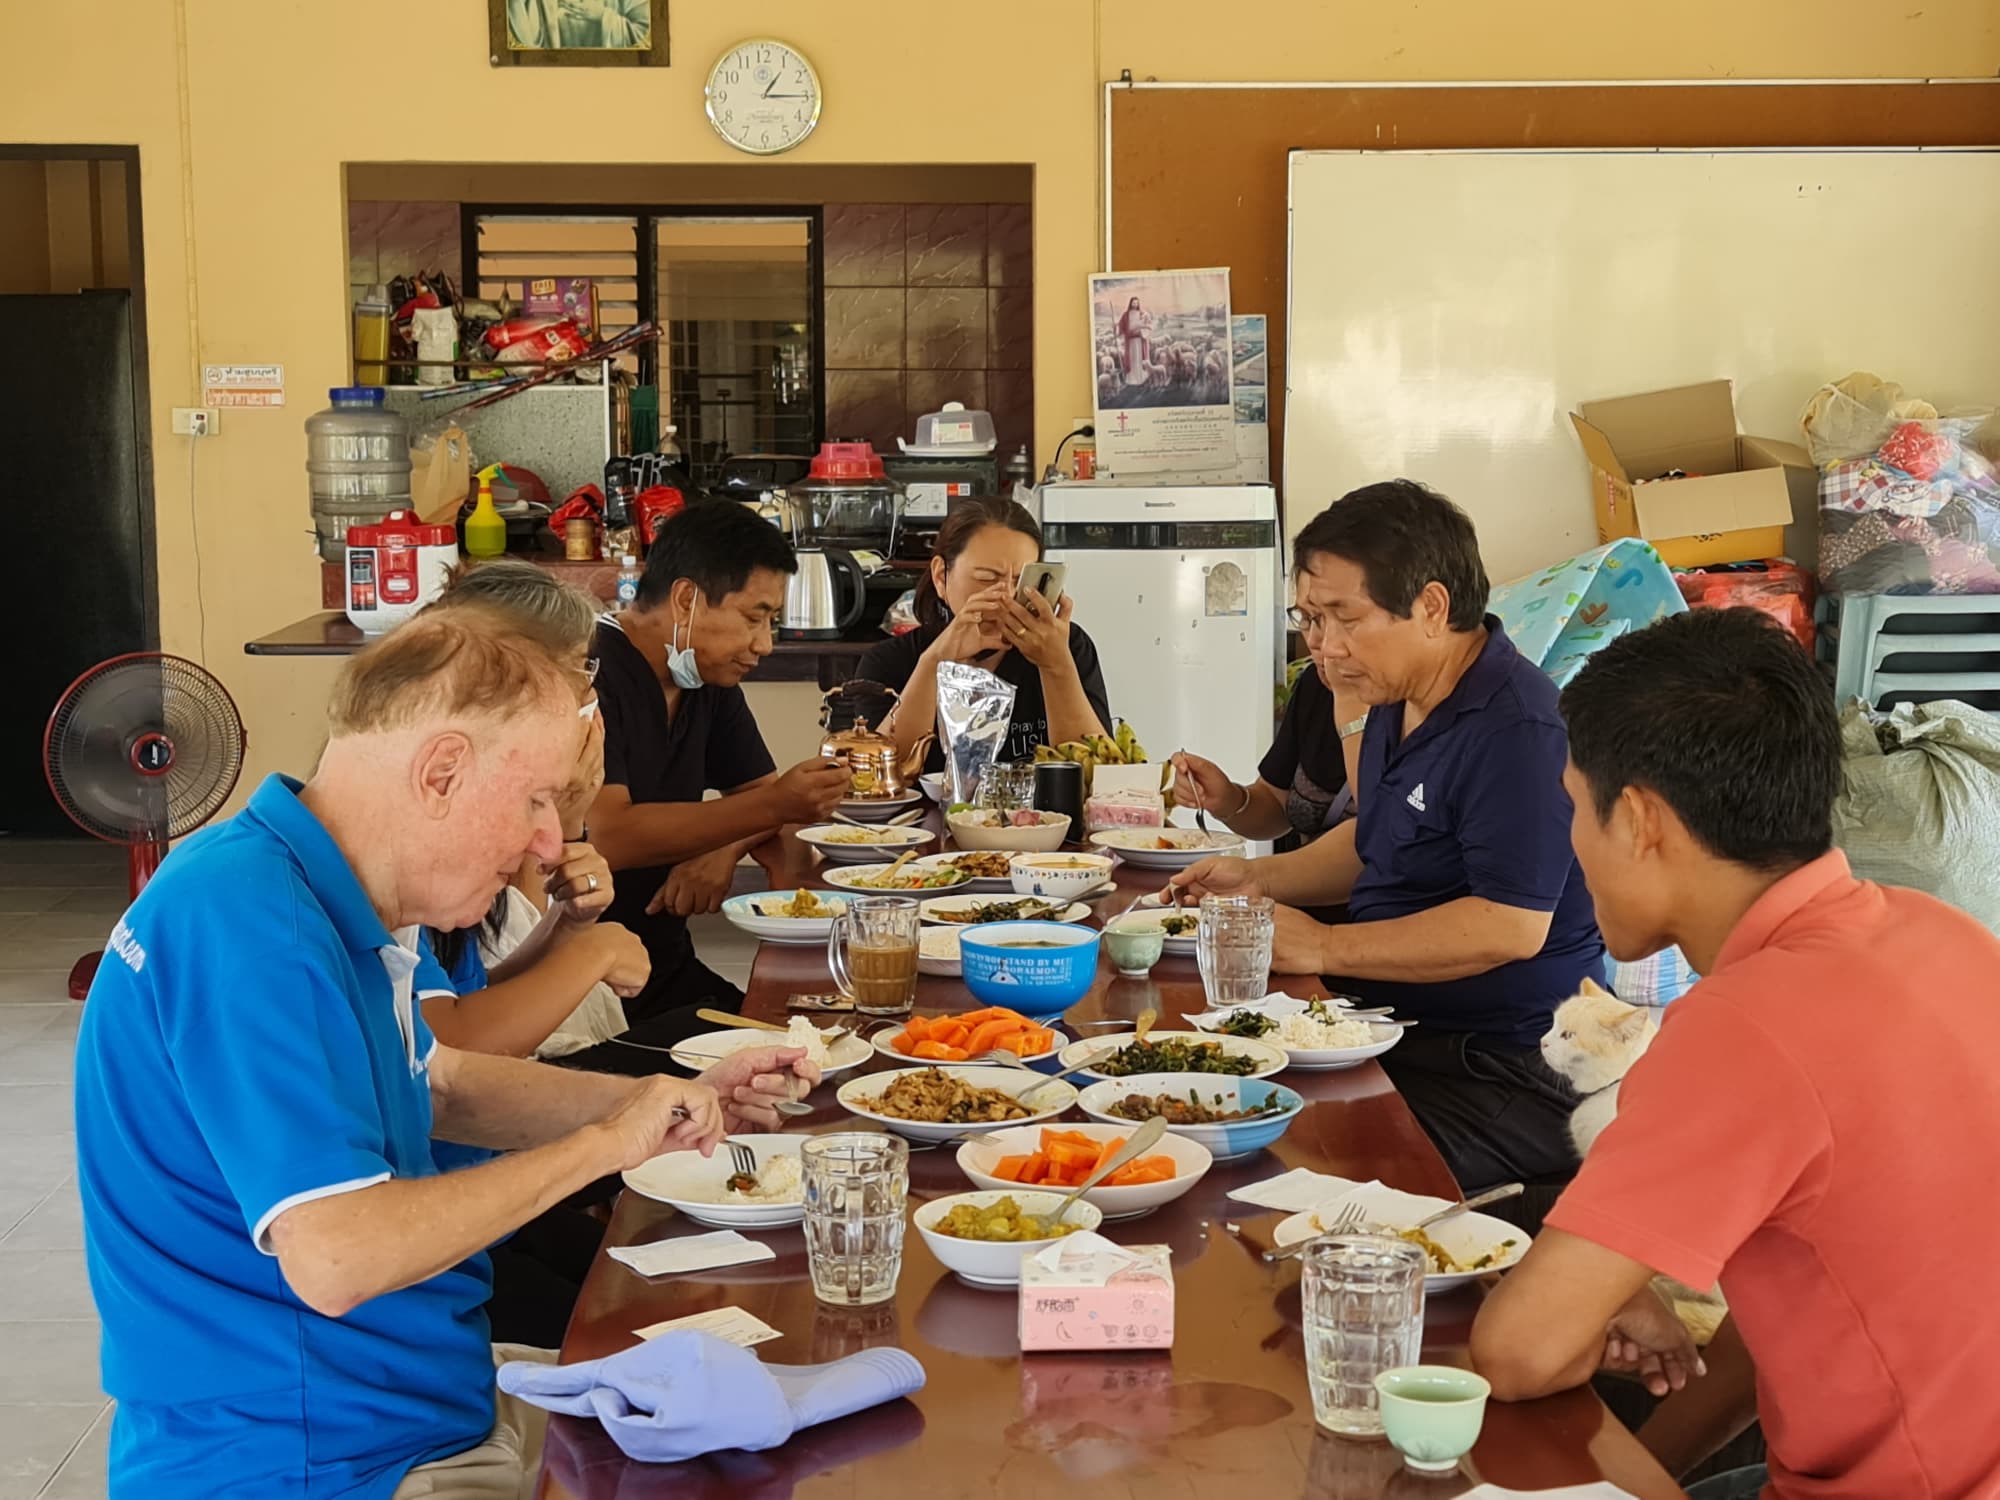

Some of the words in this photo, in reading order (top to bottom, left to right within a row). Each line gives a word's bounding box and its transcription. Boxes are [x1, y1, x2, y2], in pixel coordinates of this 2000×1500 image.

[738, 55, 749, 69] 11
[757, 49, 771, 63] 12
[725, 70, 740, 84] 10
[795, 70, 803, 84] 2
[718, 90, 728, 104] 9
[800, 89, 809, 104] 3
[724, 109, 734, 122] 8
[793, 109, 802, 122] 4
[741, 125, 750, 138] 7
[760, 130, 769, 143] 6
[781, 125, 789, 138] 5
[1010, 722, 1033, 734] Pray
